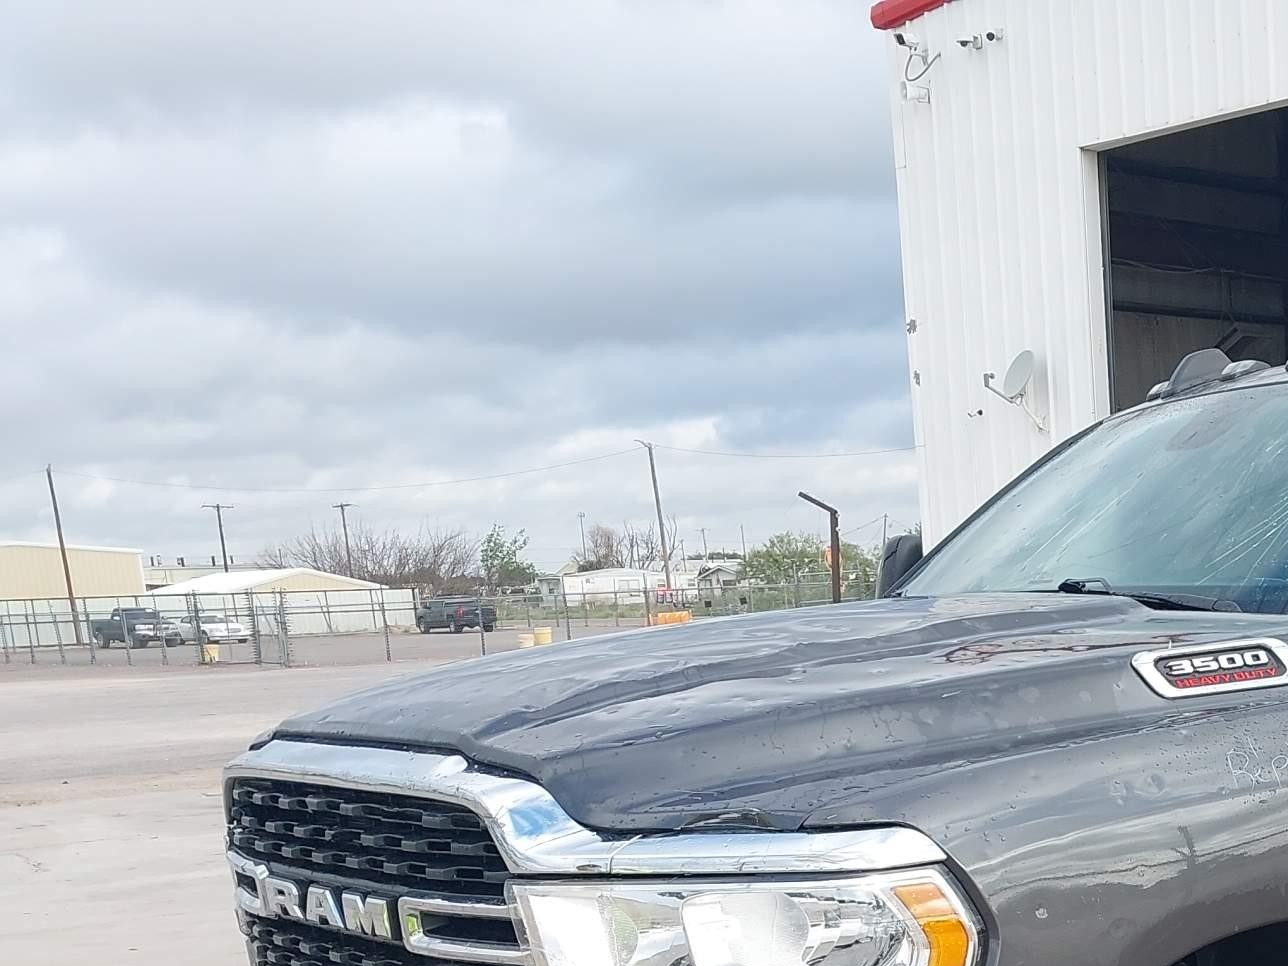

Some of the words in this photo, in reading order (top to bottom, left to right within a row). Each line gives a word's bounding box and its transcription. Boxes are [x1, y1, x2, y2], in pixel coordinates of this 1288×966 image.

[1166, 650, 1270, 676] 3500
[1175, 675, 1231, 688] HEAVY
[1233, 667, 1278, 682] DUTY
[264, 877, 393, 939] RAM
